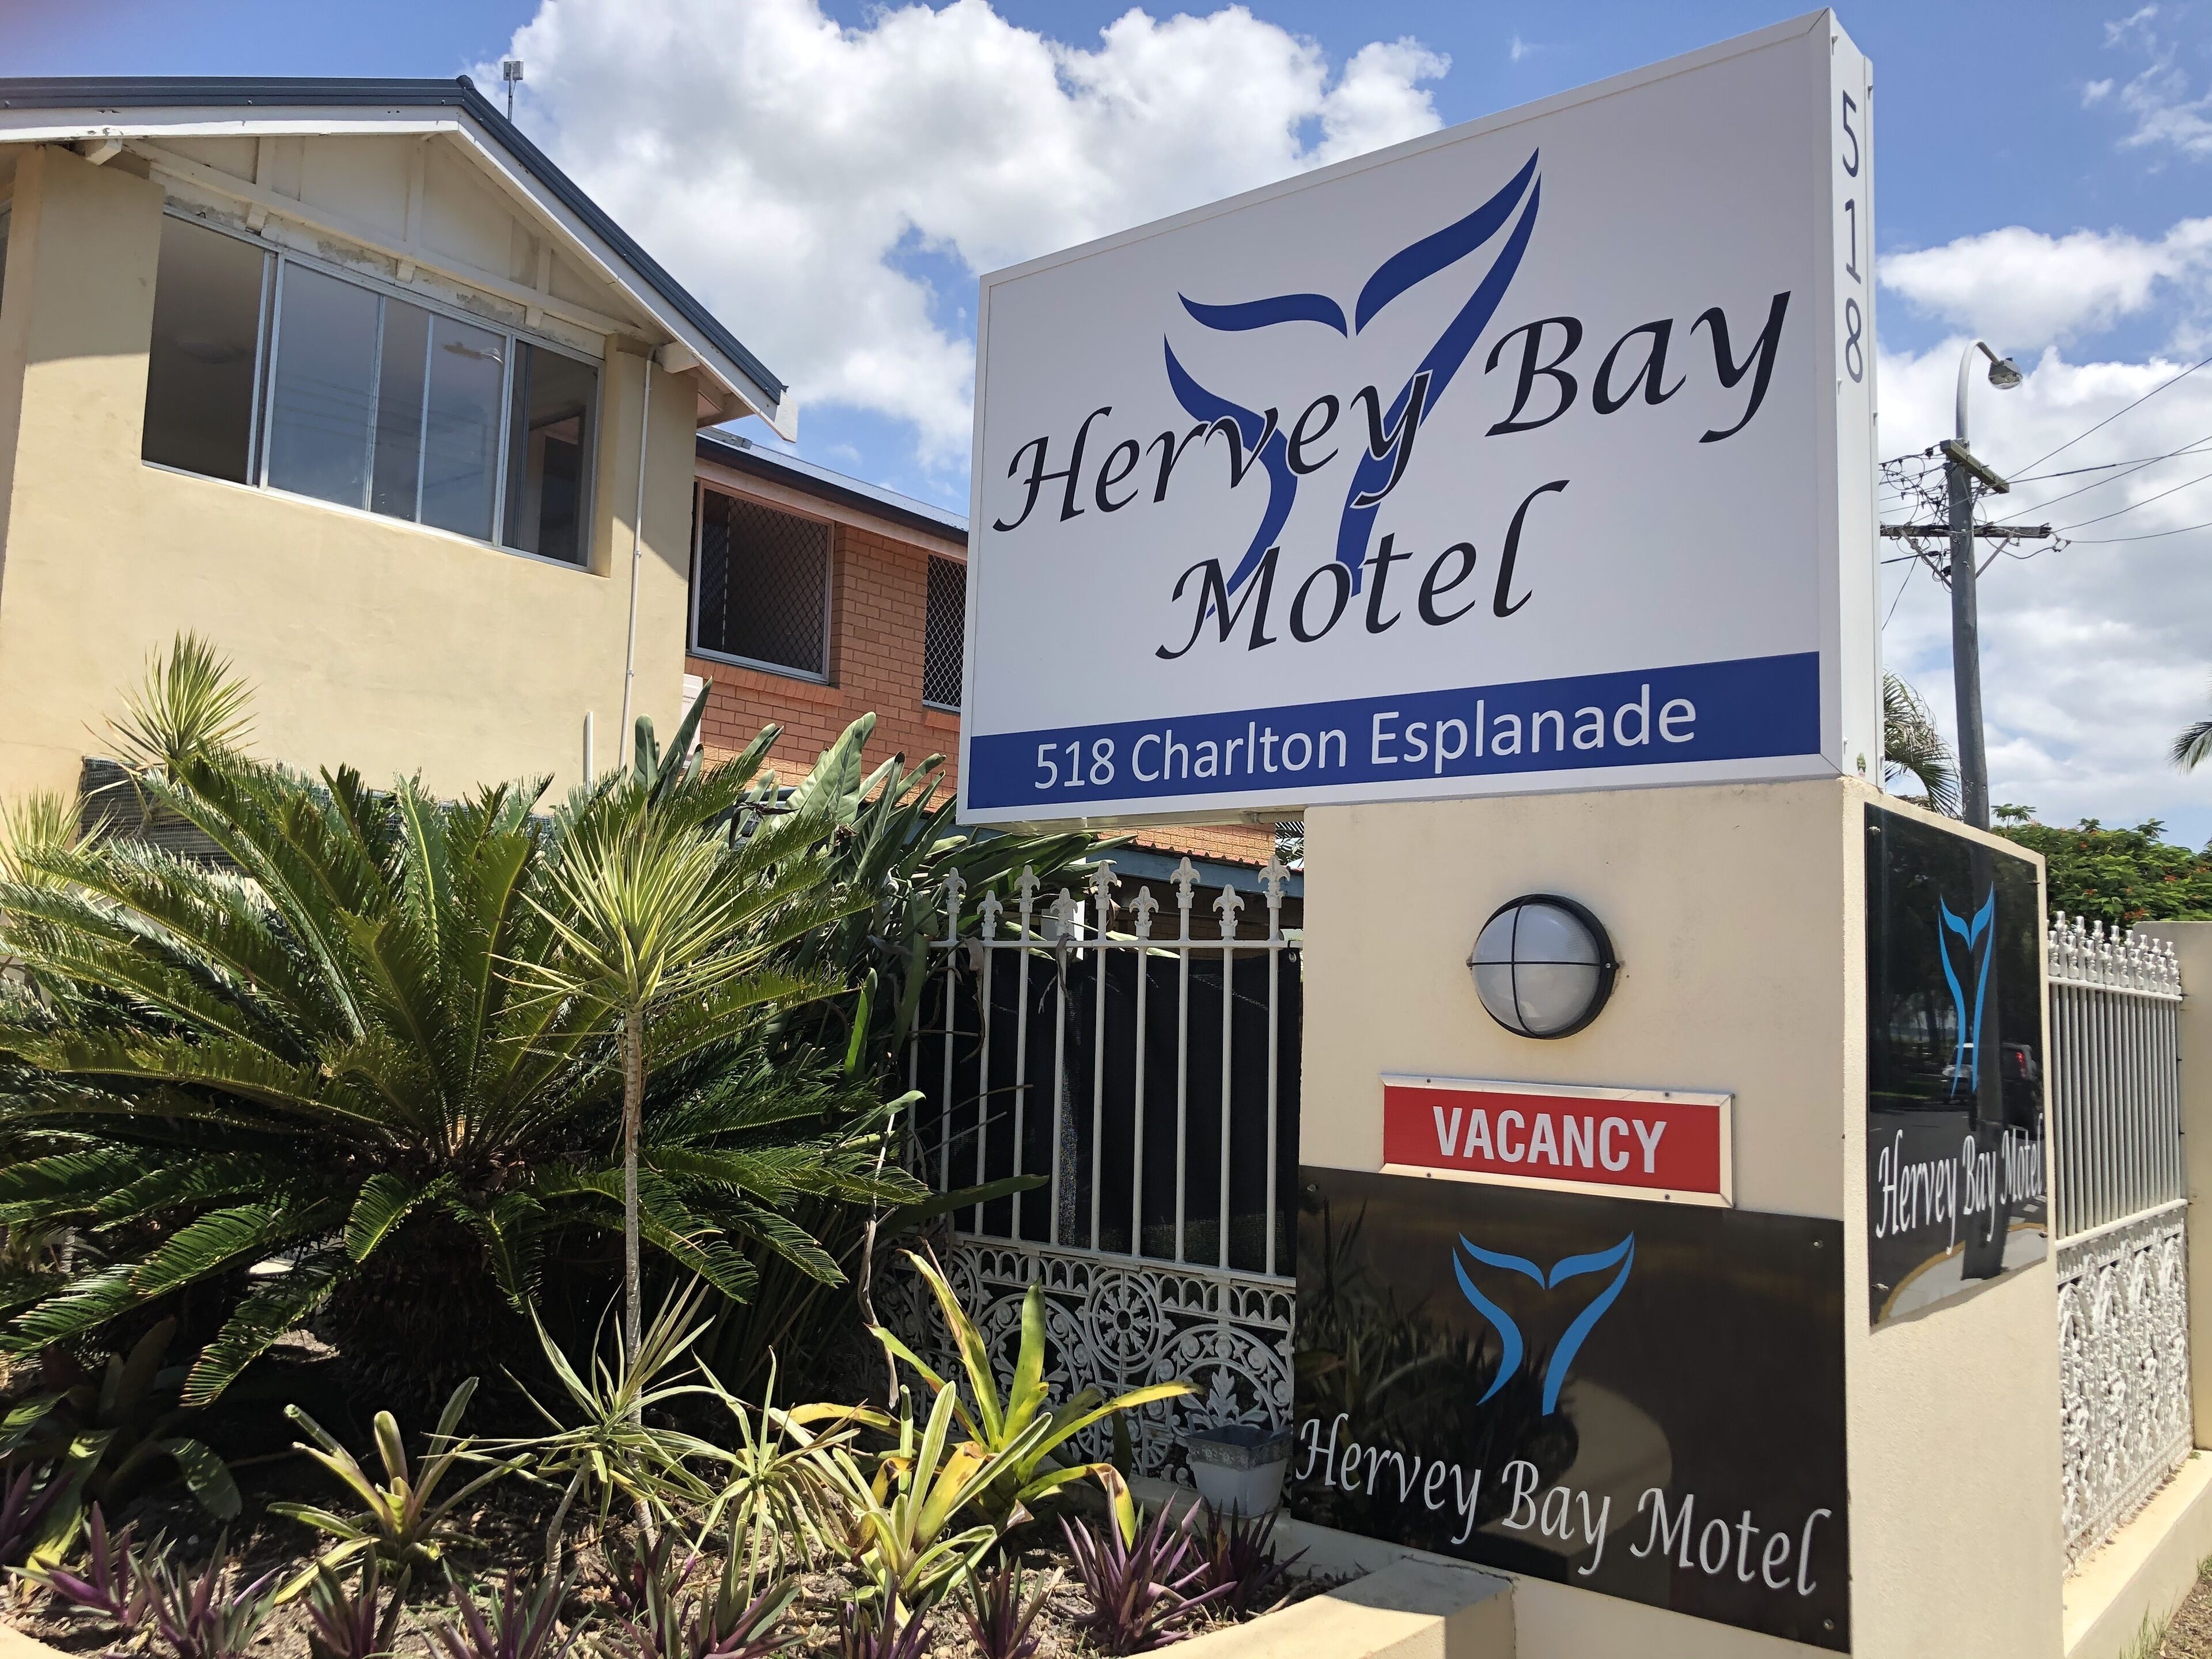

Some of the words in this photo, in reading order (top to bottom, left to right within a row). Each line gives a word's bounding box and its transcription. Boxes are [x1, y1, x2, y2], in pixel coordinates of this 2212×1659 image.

[1842, 89, 1863, 384] 518
[992, 372, 1430, 532] Hervey
[1484, 290, 1791, 444] Bay
[1155, 479, 1570, 660] Motel
[1034, 737, 1115, 790] 518
[1132, 721, 1347, 782] Charlton
[1371, 683, 1696, 775] Esplanade
[1432, 1105, 1668, 1174] VACANCY
[1875, 1128, 1957, 1256] Hervey
[1961, 1134, 1997, 1243] Bay
[1999, 1112, 2044, 1205] Motel
[1295, 1412, 1482, 1546] Hervey
[1501, 1459, 1611, 1575] Bay
[1629, 1487, 1832, 1596] Motel
